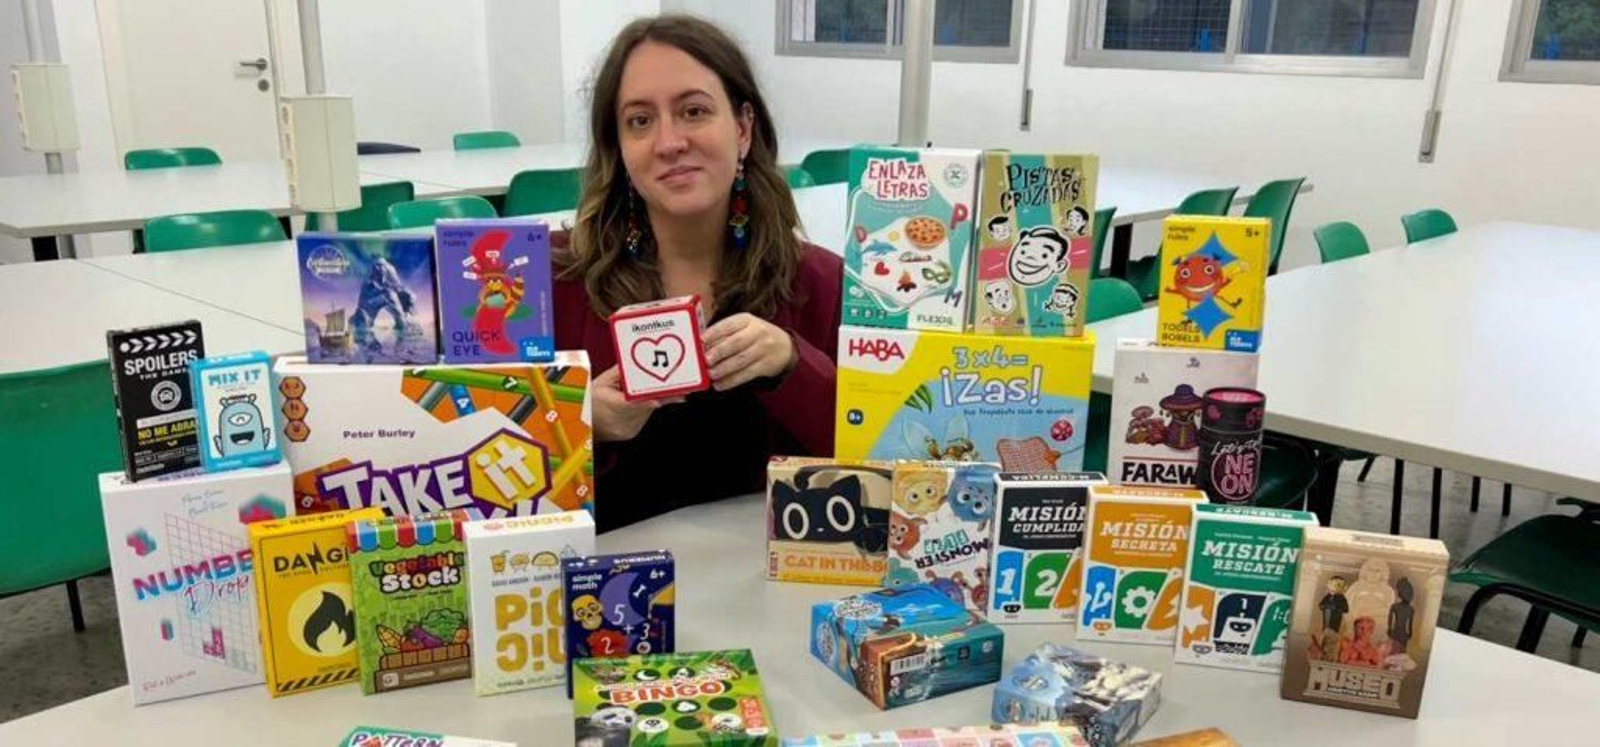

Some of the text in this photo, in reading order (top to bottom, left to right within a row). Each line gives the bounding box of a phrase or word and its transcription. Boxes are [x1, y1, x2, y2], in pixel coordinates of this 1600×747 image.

[869, 160, 926, 179] ENLAZA
[1007, 163, 1075, 191] PISTAS
[877, 180, 928, 199] LETRAS
[1001, 180, 1081, 213] CRUZADAS
[951, 203, 968, 230] P
[1245, 228, 1260, 237] 5+
[944, 287, 962, 307] M
[632, 320, 675, 333] ikonikus
[917, 315, 953, 325] FLEXIQ
[453, 331, 501, 343] QUICK
[453, 344, 481, 356] EYE
[849, 338, 905, 361] HABA
[124, 349, 197, 376] SPOILERS
[140, 372, 158, 380] THE
[209, 369, 261, 386] MIX IT
[940, 364, 1043, 407] ¡Zas!
[138, 428, 152, 439] NO
[154, 425, 168, 436] ME
[343, 428, 416, 439] Peter Burley
[1121, 461, 1199, 485] FARAW
[1225, 452, 1254, 474] NE
[323, 438, 536, 516] TAKE it
[1221, 473, 1253, 495] ON
[1101, 519, 1188, 540] MISIÓN
[914, 538, 989, 569] MONSTER
[1112, 539, 1177, 552] SECRETA
[1201, 539, 1299, 564] MISIÓN
[273, 542, 350, 575] DANG
[785, 554, 815, 568] CAT
[820, 556, 836, 569] IN
[1213, 558, 1286, 575] RESCATE
[381, 566, 461, 593] Stock
[572, 573, 602, 583] simple
[650, 569, 666, 579] 6+
[997, 568, 1016, 596] 1
[1034, 569, 1058, 597] 2
[572, 582, 598, 590] math
[612, 603, 625, 626] 5
[640, 623, 650, 640] 3
[611, 680, 724, 704] BINGO
[1308, 664, 1402, 702] MUSEO
